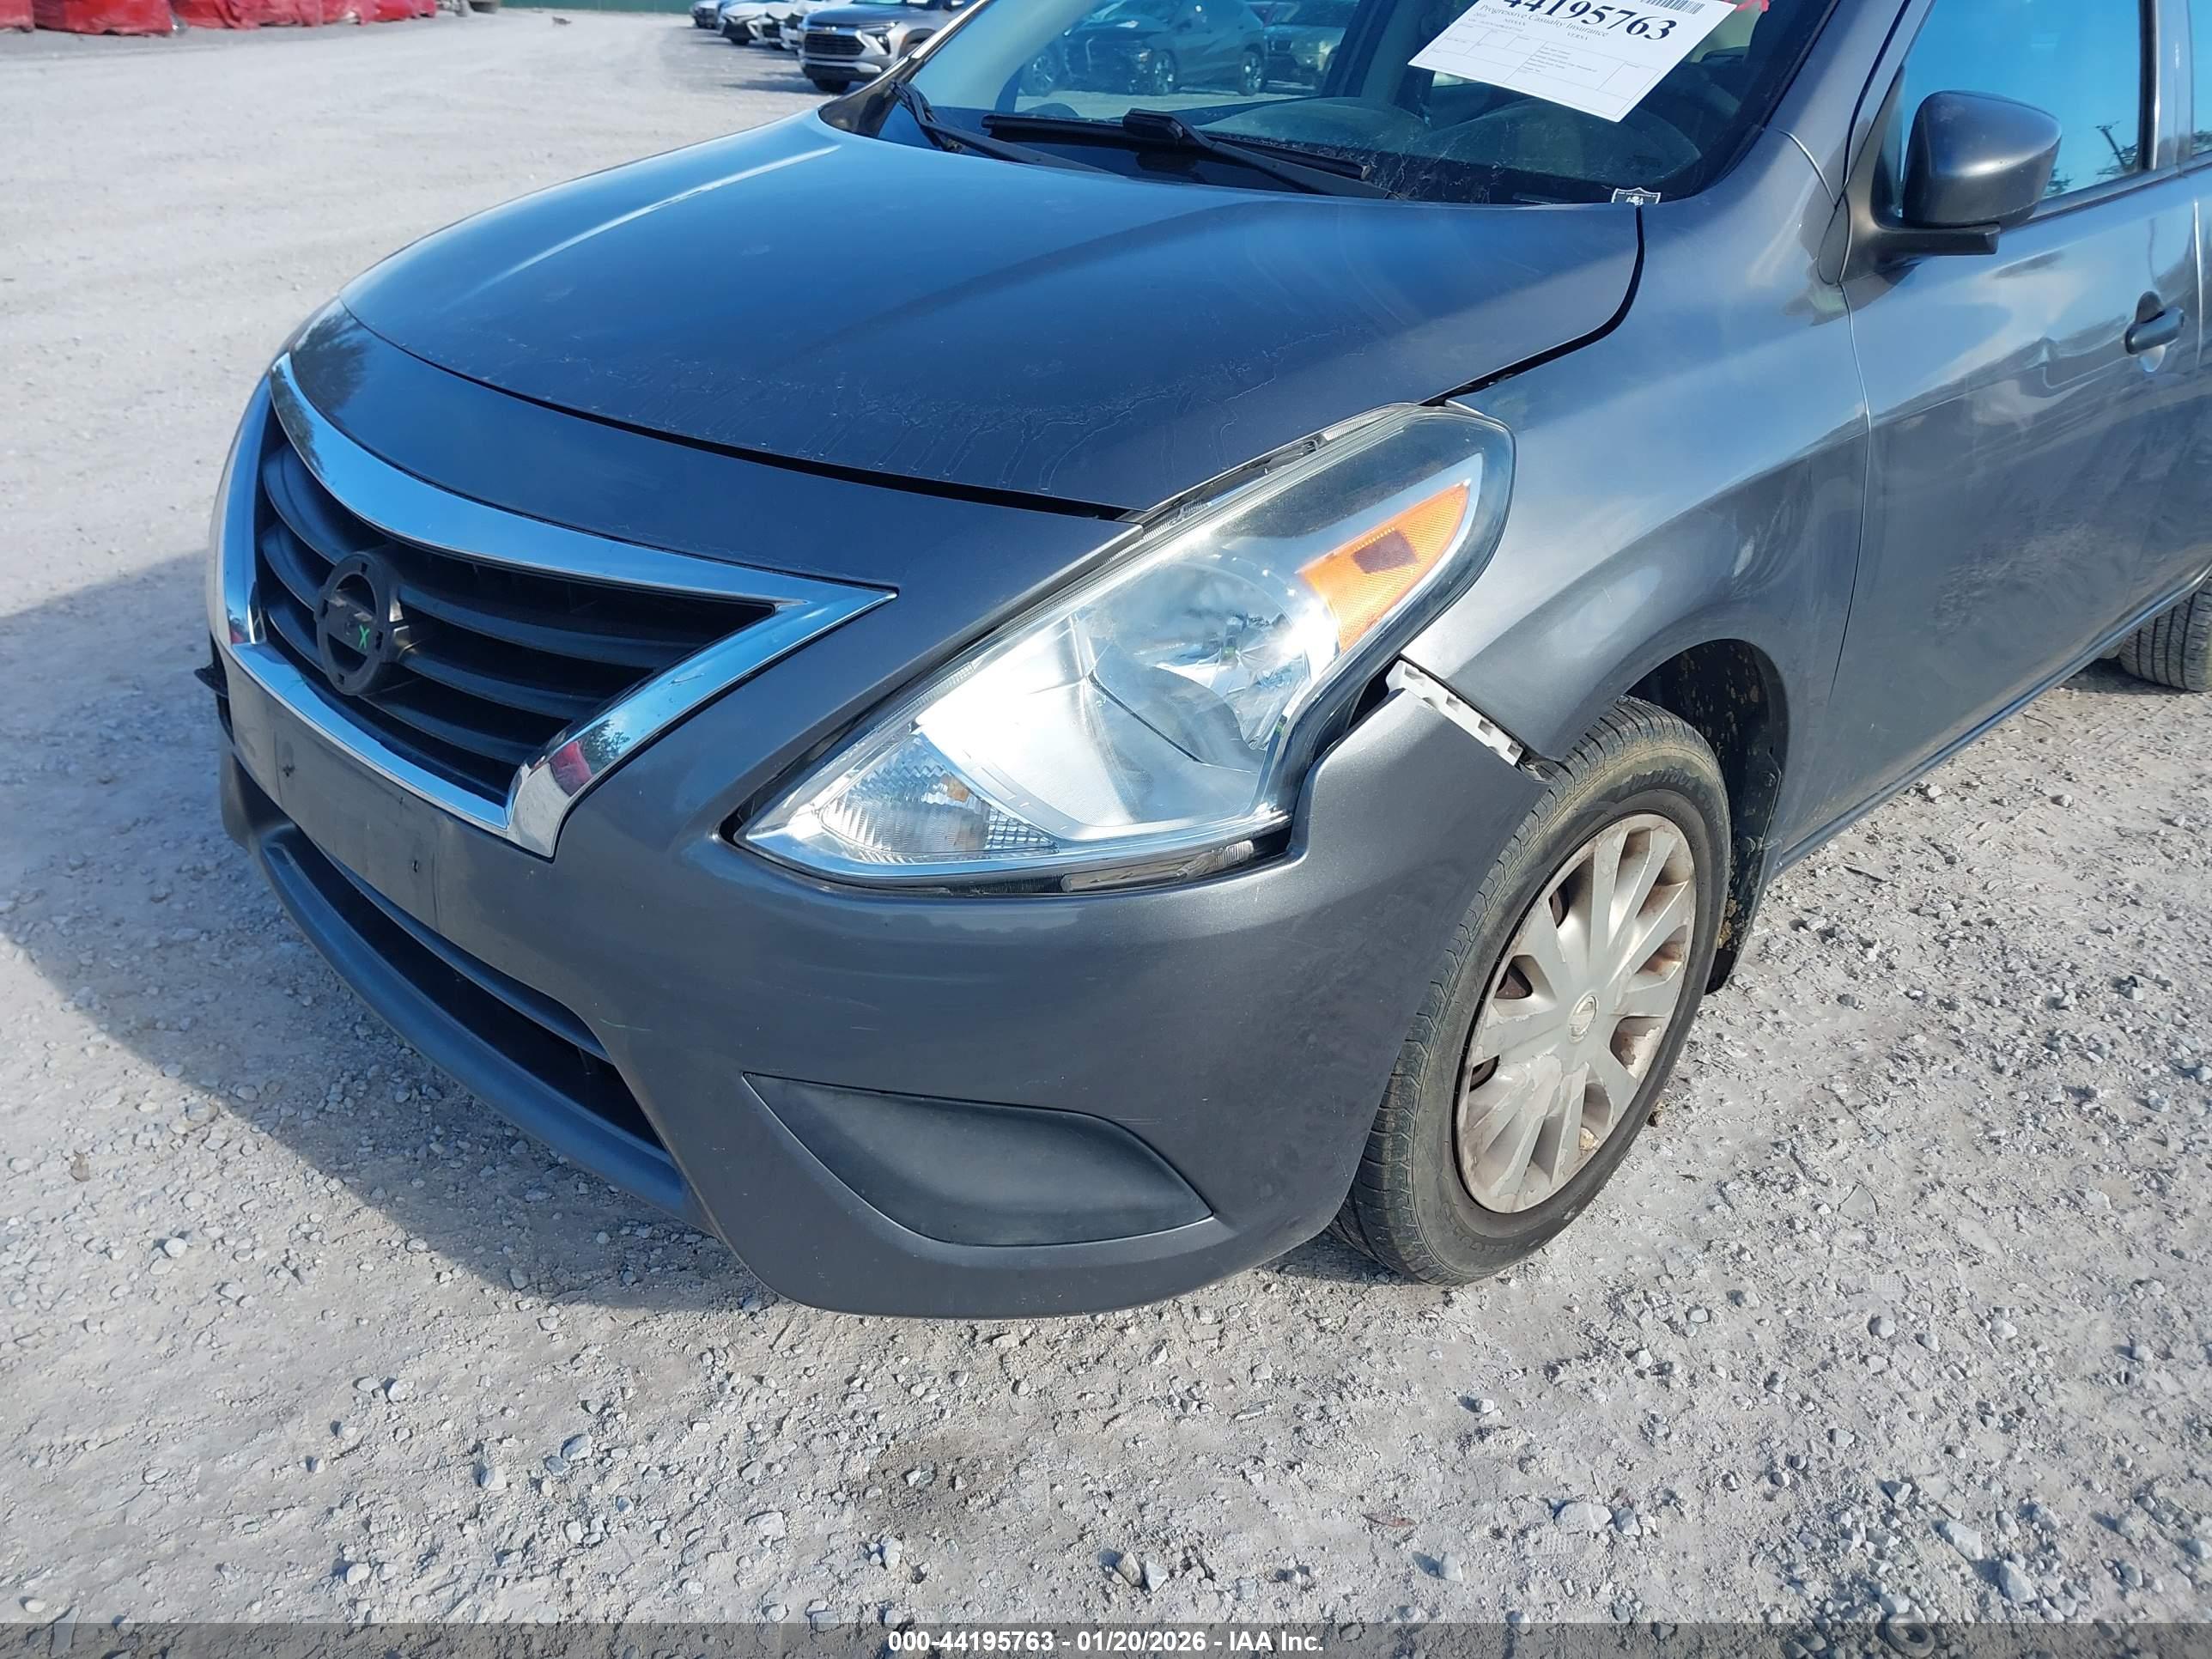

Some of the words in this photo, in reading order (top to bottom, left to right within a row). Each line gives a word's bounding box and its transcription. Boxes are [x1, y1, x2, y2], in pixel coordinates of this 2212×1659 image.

[1480, 4, 1527, 19] Progressive
[1528, 14, 1565, 27] Casualty
[1566, 22, 1609, 37] Insurance
